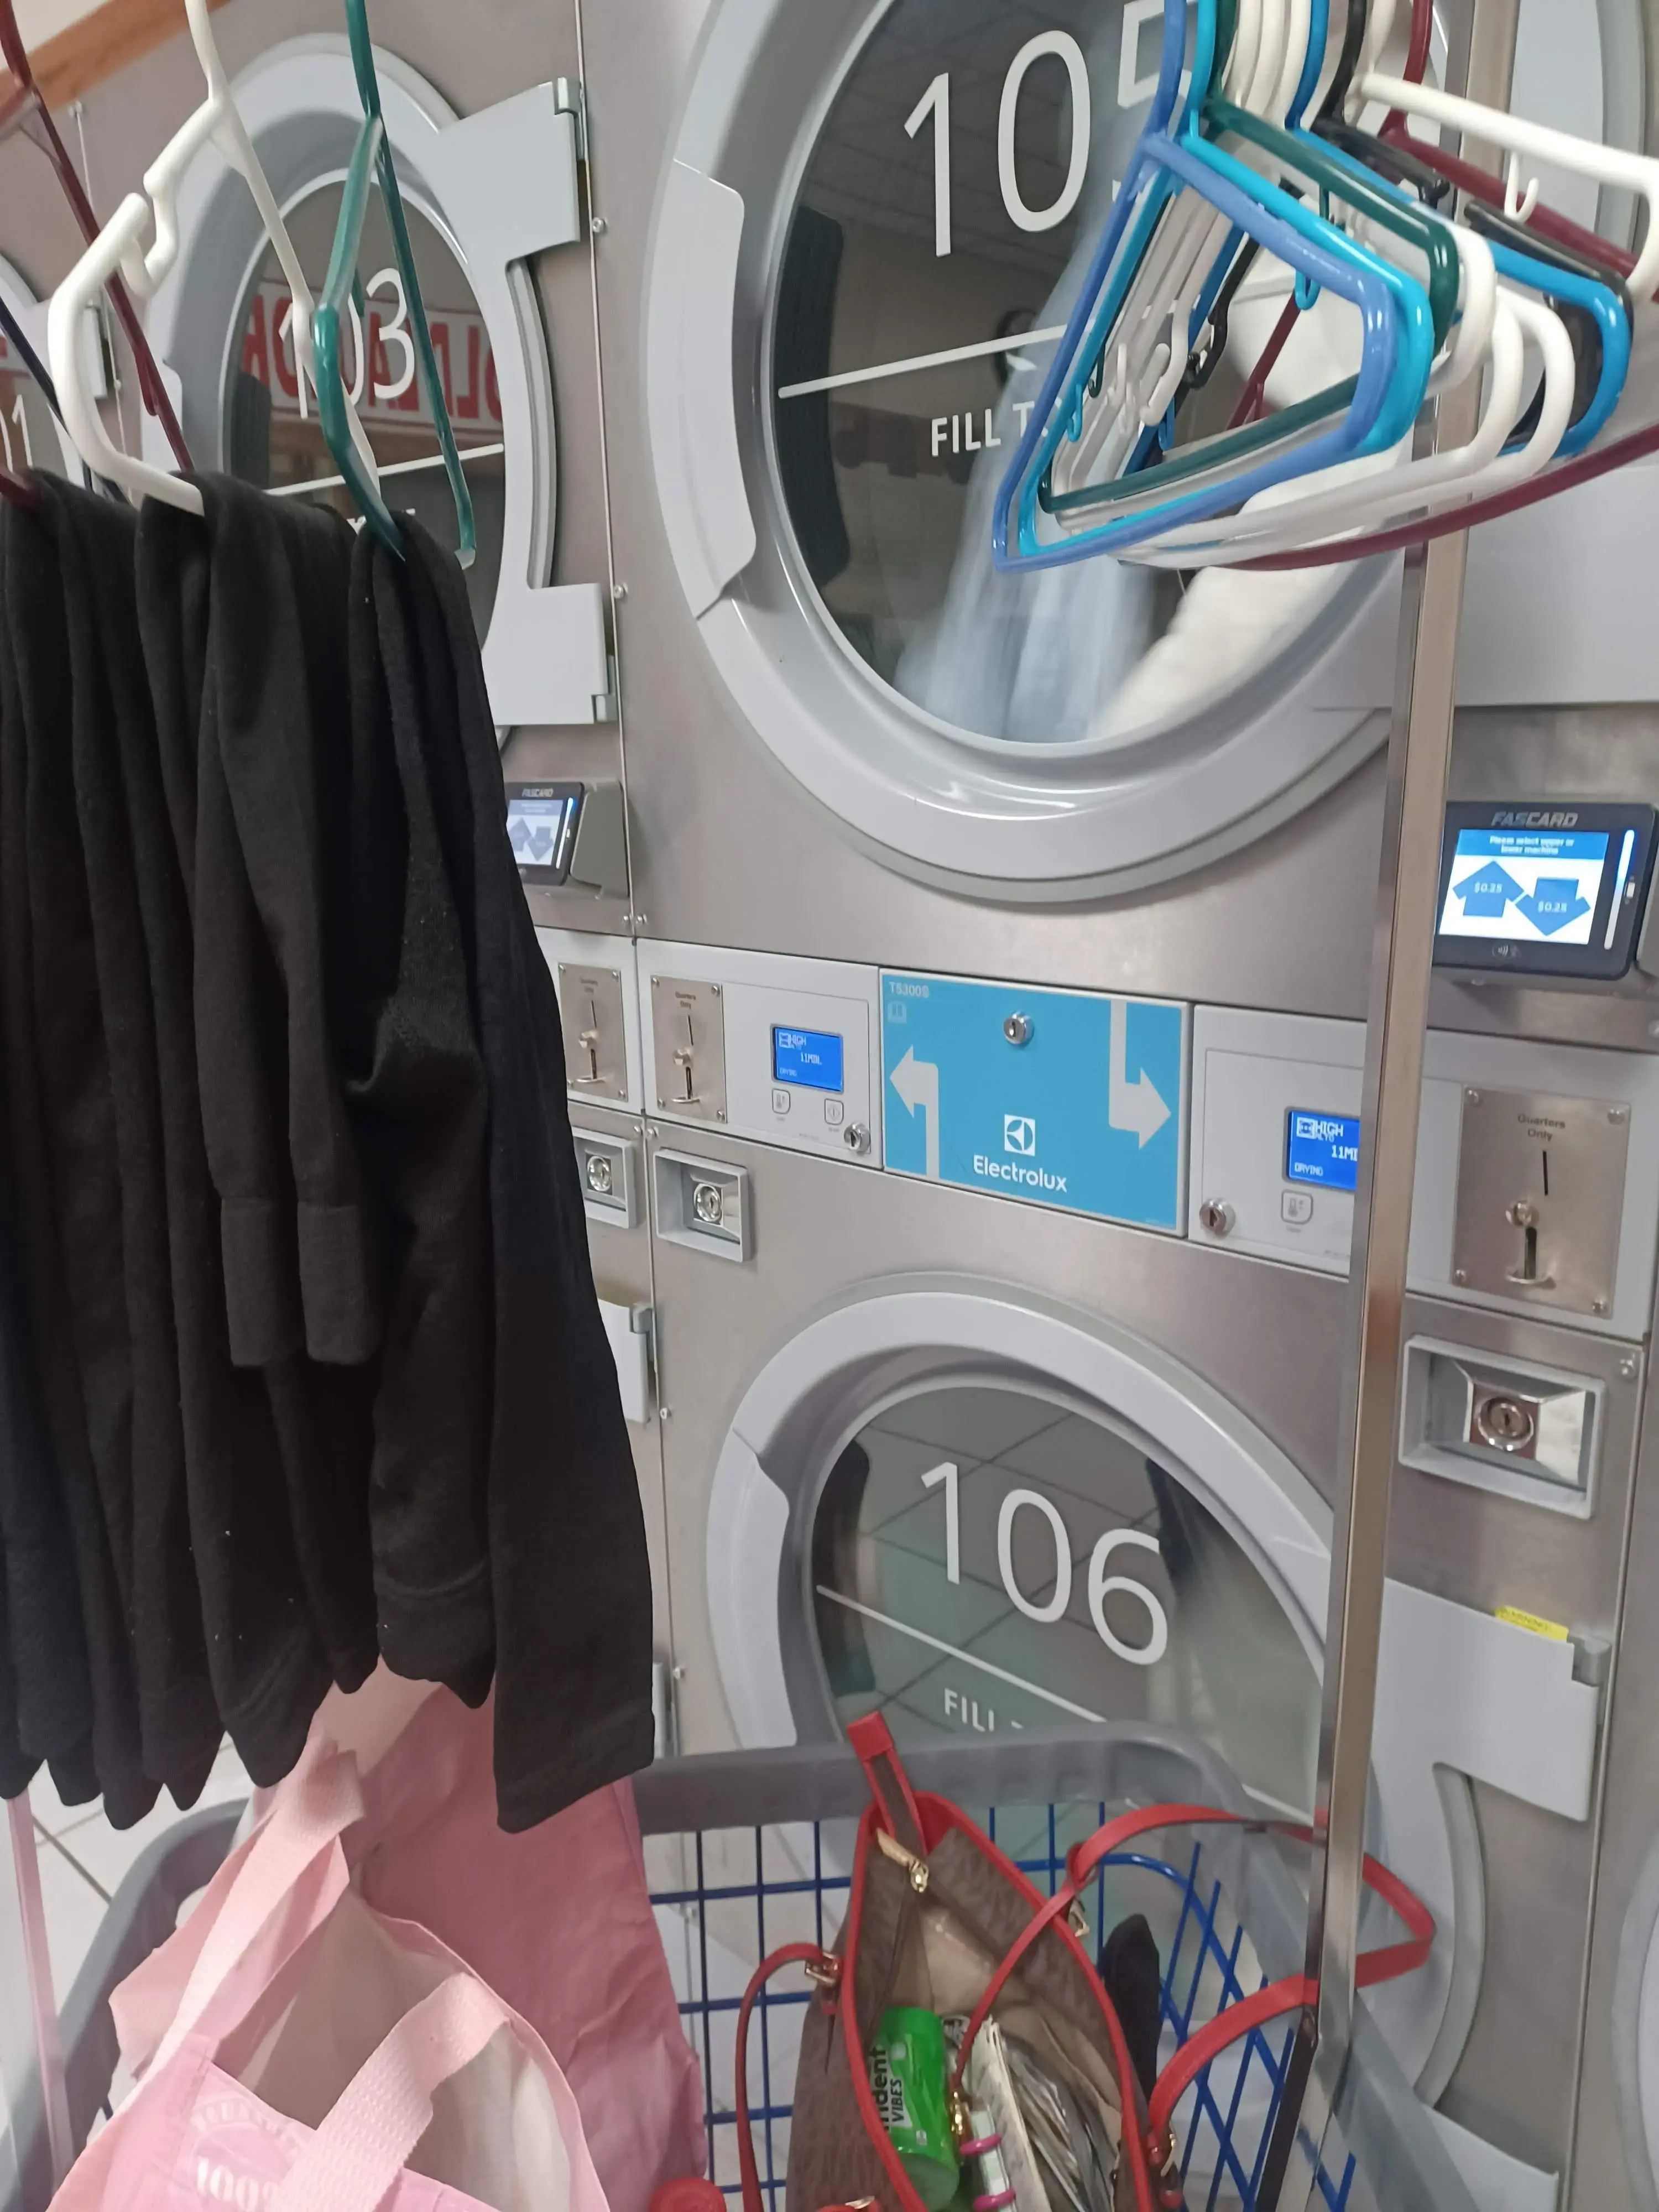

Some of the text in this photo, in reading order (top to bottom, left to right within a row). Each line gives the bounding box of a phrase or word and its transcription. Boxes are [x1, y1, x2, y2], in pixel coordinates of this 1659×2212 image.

[931, 408, 1001, 457] FILL
[1491, 811, 1578, 828] FASCARD
[1315, 1120, 1344, 1137] HIGH
[1517, 1113, 1566, 1129] Quarters
[1527, 1128, 1553, 1142] Only
[1331, 1144, 1358, 1162] 11MI
[973, 1154, 1067, 1193] Electrolux
[920, 1461, 1168, 1665] 106
[890, 2078, 904, 2122] VIBES
